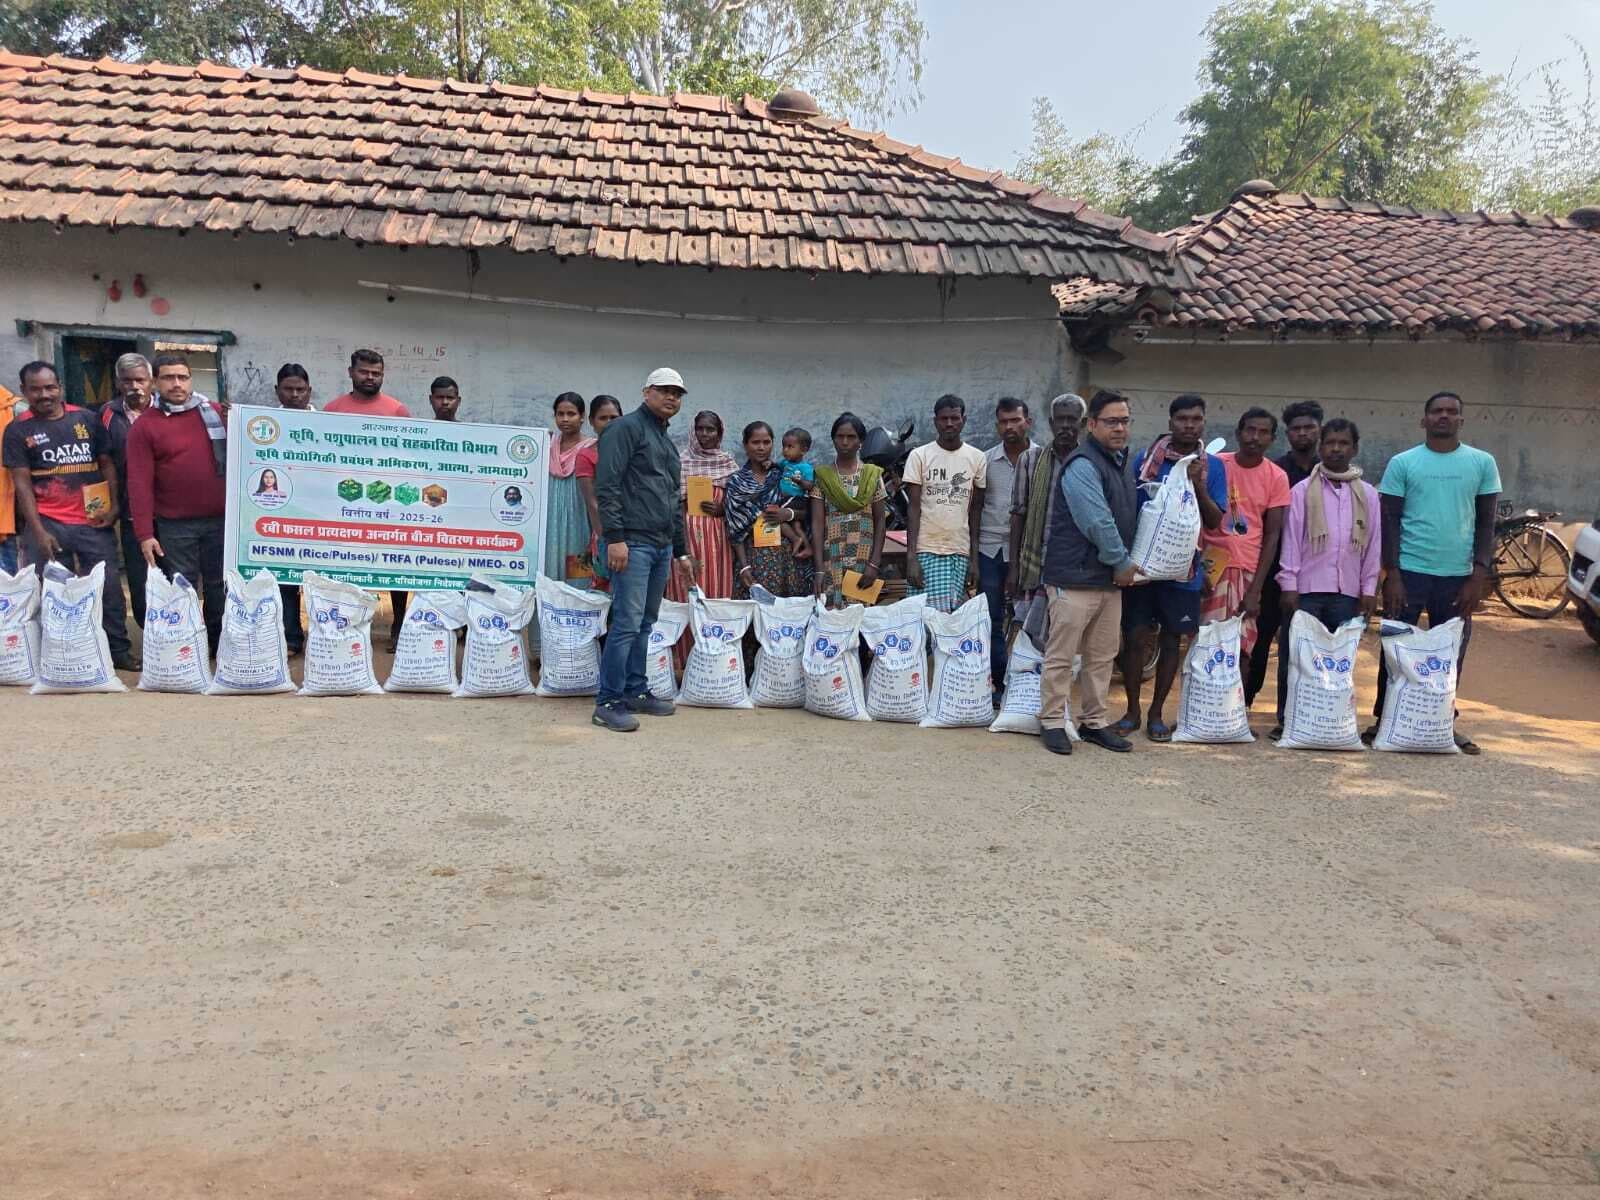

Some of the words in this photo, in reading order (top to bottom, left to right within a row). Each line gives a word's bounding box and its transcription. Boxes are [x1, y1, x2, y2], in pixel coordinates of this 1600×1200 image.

[400, 425, 428, 435] सरकार
[289, 428, 319, 444] कृषि,
[324, 432, 377, 447] पशुपालन
[381, 435, 398, 447] एवं
[401, 438, 458, 452] सहकारिता
[462, 440, 498, 455] विभाग
[42, 442, 91, 462] QATAR
[58, 454, 93, 464] AIRWAYS
[255, 448, 279, 461] कृषि
[477, 465, 529, 479] जामताड़ा)
[341, 506, 372, 518] वित्तीय
[400, 512, 444, 524] 2025-26
[283, 524, 315, 537] फसल
[437, 532, 473, 546] वितरण
[476, 535, 518, 548] कार्यक्रम
[252, 544, 295, 557] NFSNM
[382, 553, 412, 563] TRFA
[509, 560, 525, 570] OS
[551, 614, 563, 625] HIL
